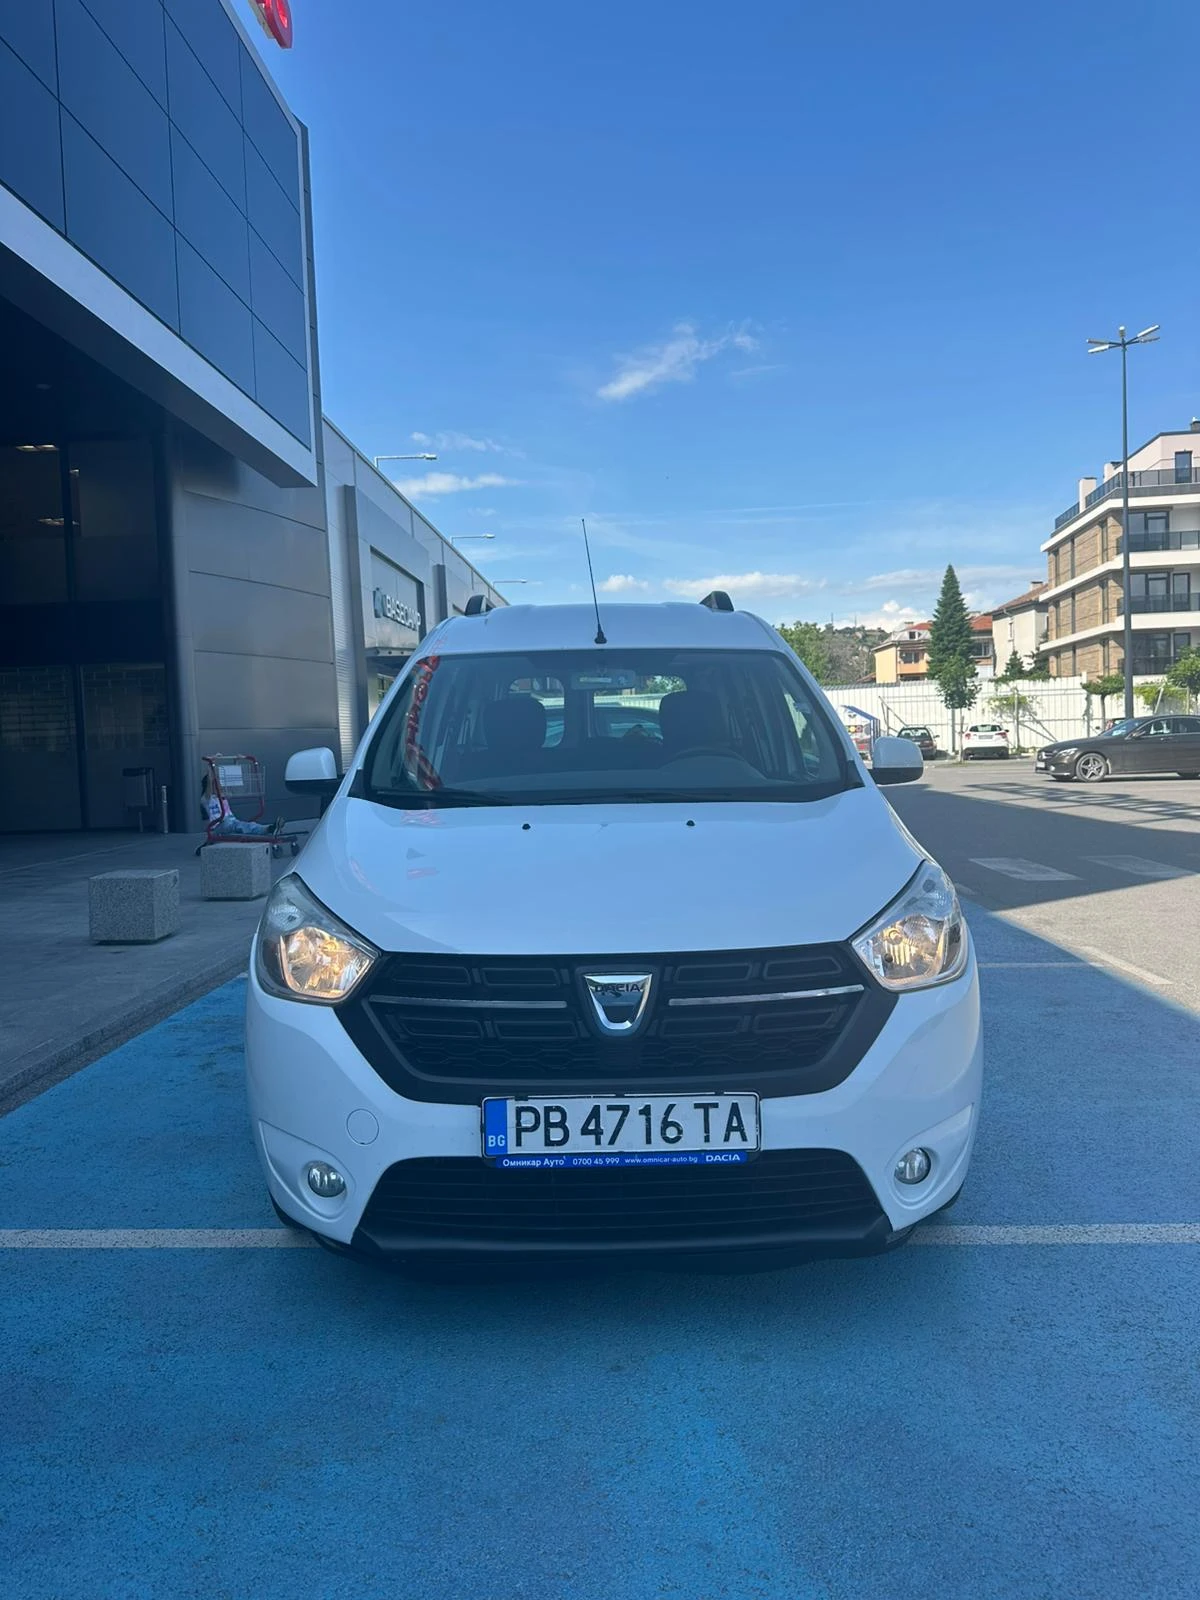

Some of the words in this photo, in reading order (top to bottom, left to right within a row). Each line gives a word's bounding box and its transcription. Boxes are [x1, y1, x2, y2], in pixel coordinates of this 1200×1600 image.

[595, 983, 640, 992] DACIA
[515, 1105, 570, 1147] PB
[580, 1103, 684, 1146] 4716
[693, 1102, 749, 1143] TA
[488, 1134, 506, 1147] BG
[605, 1157, 620, 1165] 999
[624, 1155, 698, 1164] www.omnicar-auto.bg
[705, 1153, 740, 1162] DACIA
[502, 1158, 541, 1167] Омникар
